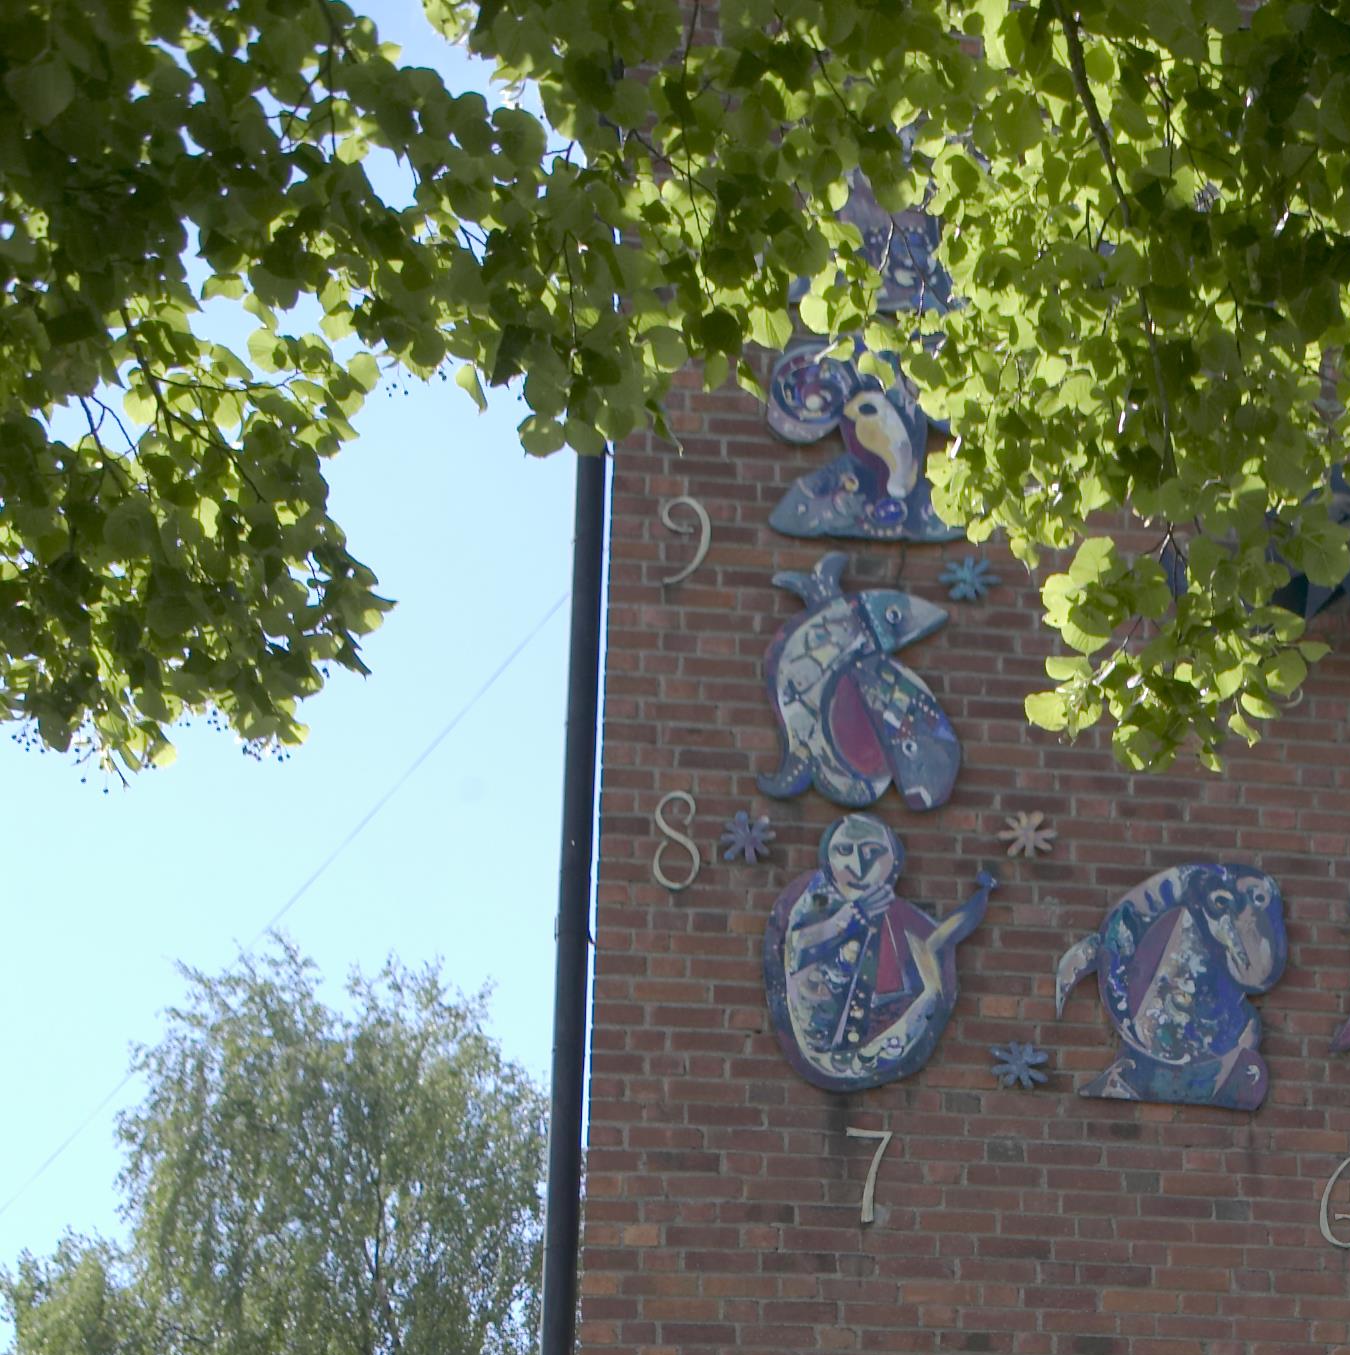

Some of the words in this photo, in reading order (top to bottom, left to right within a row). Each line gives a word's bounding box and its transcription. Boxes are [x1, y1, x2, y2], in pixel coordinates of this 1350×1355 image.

[660, 495, 711, 587] 9
[652, 790, 701, 891] 8
[845, 1126, 893, 1224] 7
